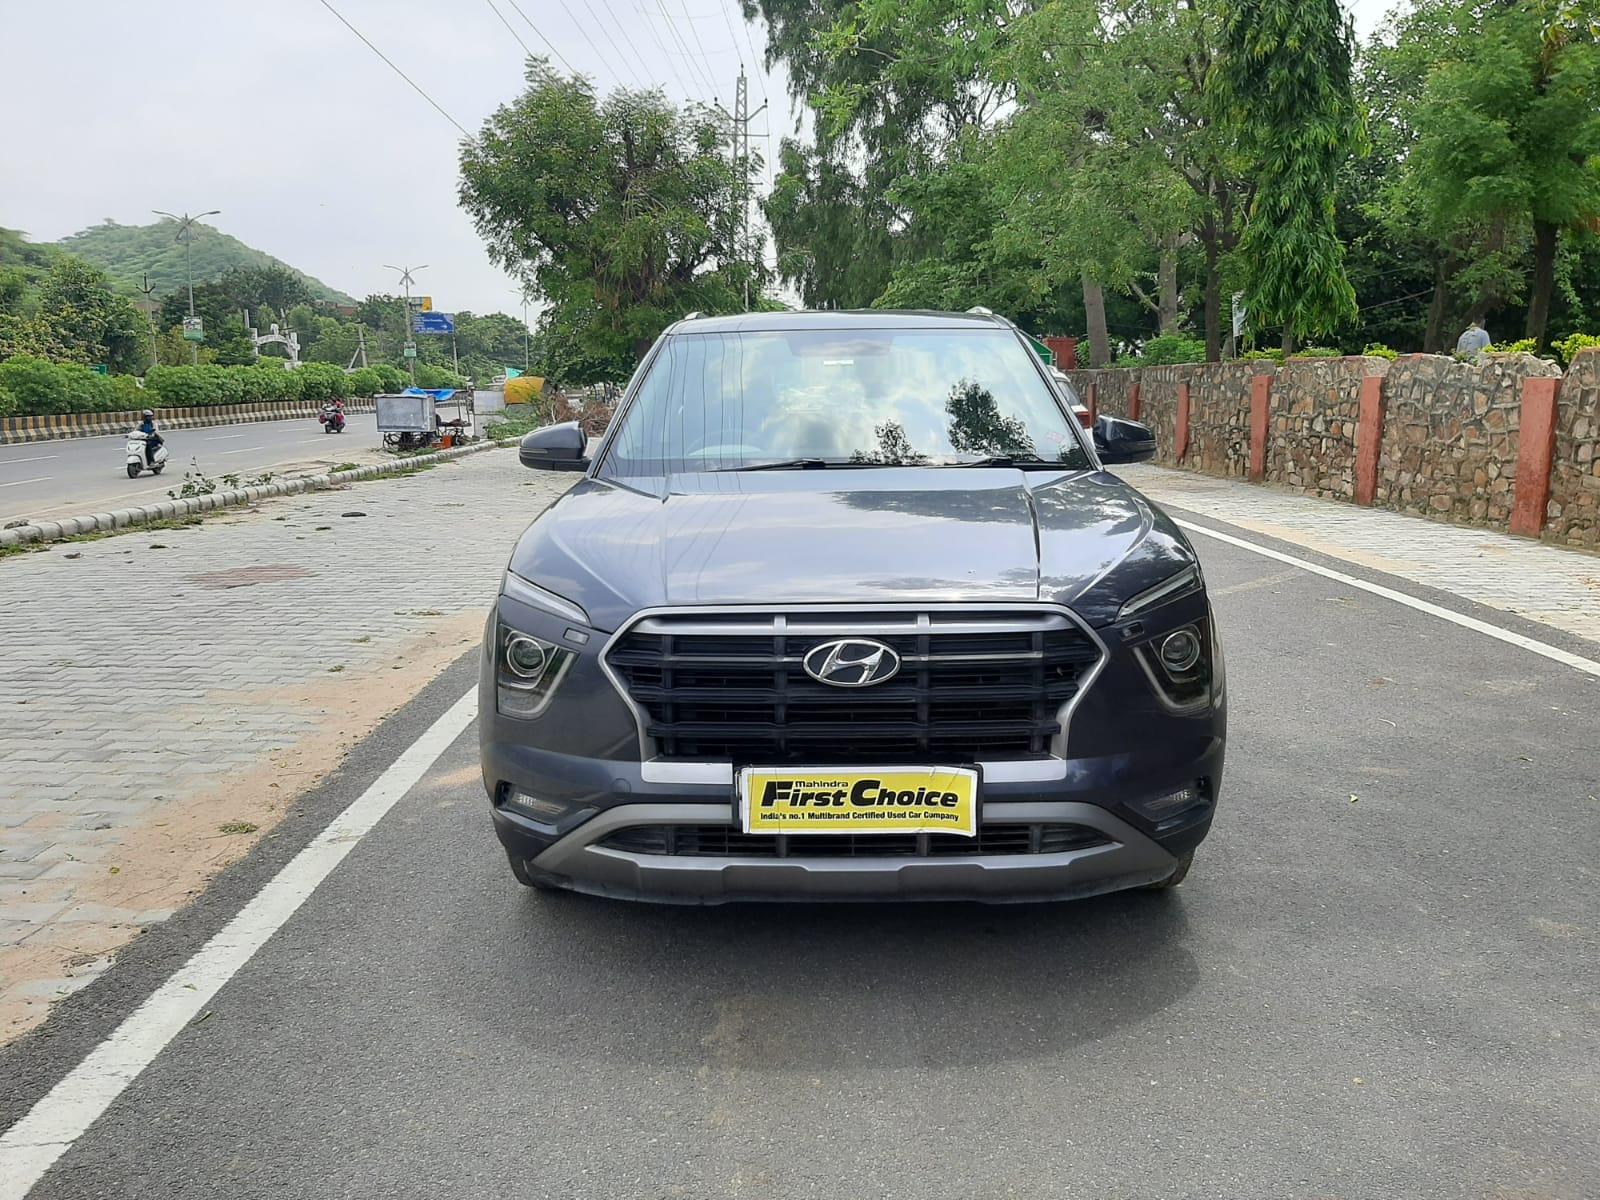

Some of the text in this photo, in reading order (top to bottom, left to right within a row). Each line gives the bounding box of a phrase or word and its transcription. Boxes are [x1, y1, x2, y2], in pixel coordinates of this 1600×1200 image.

[761, 779, 959, 807] First Choice
[761, 811, 959, 822] India's no.1 Multibrand Certified Used Car Company
